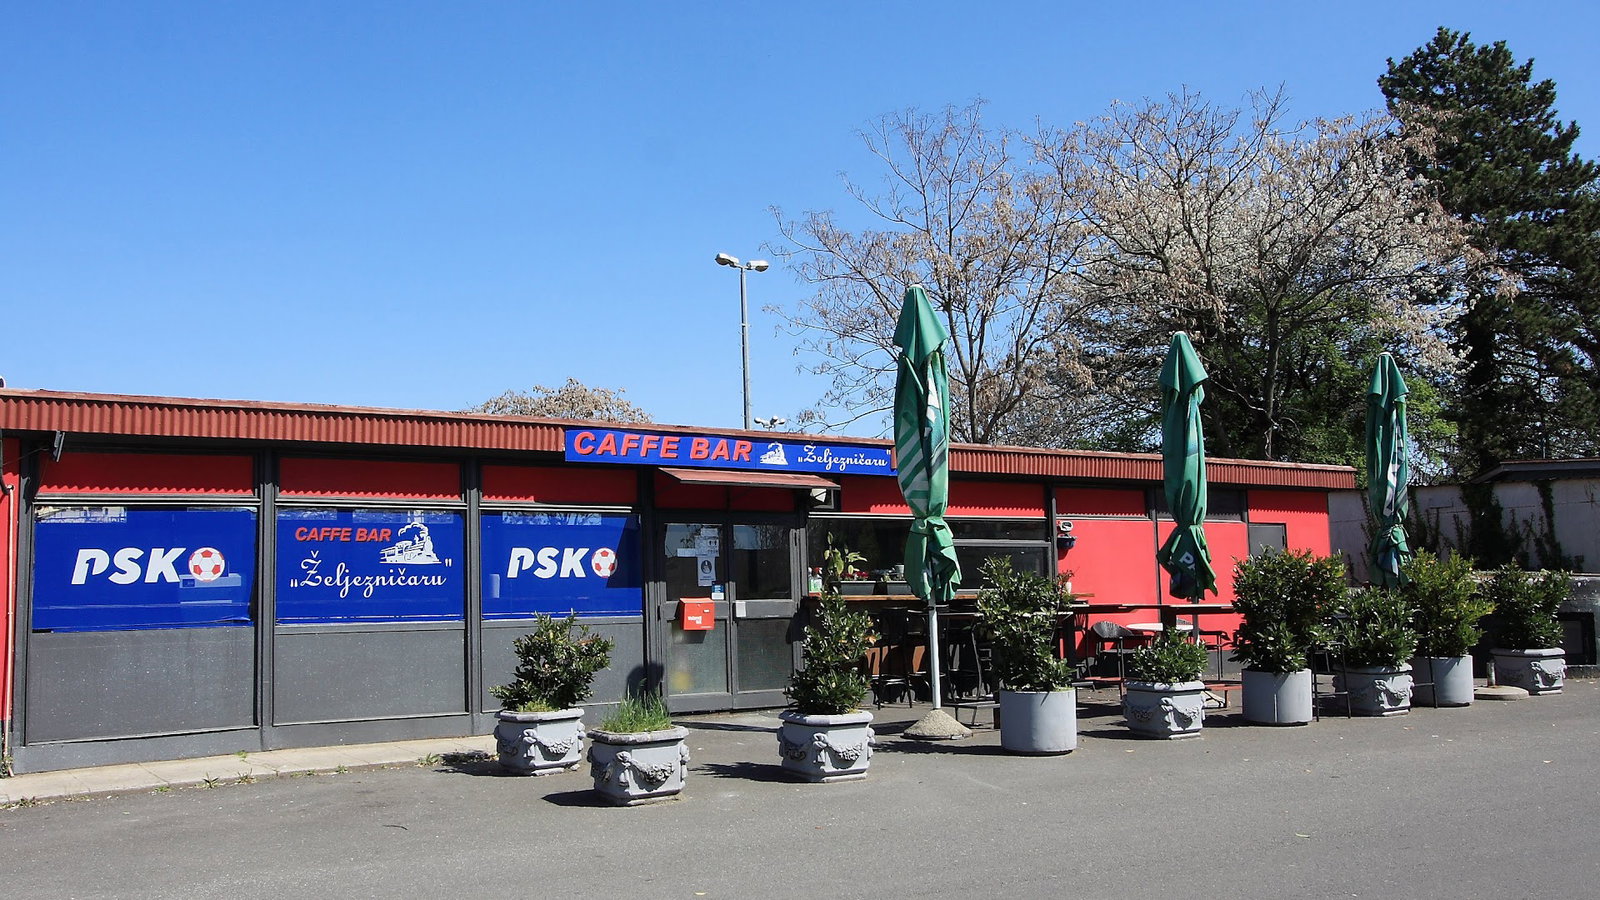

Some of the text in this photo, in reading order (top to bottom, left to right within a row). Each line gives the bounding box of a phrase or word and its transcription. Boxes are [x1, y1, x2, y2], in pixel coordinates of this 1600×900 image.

[573, 431, 754, 463] CAFFE BAR
[295, 526, 393, 543] CAFFE BAR
[71, 547, 187, 585] PSK
[506, 547, 590, 579] PSK
